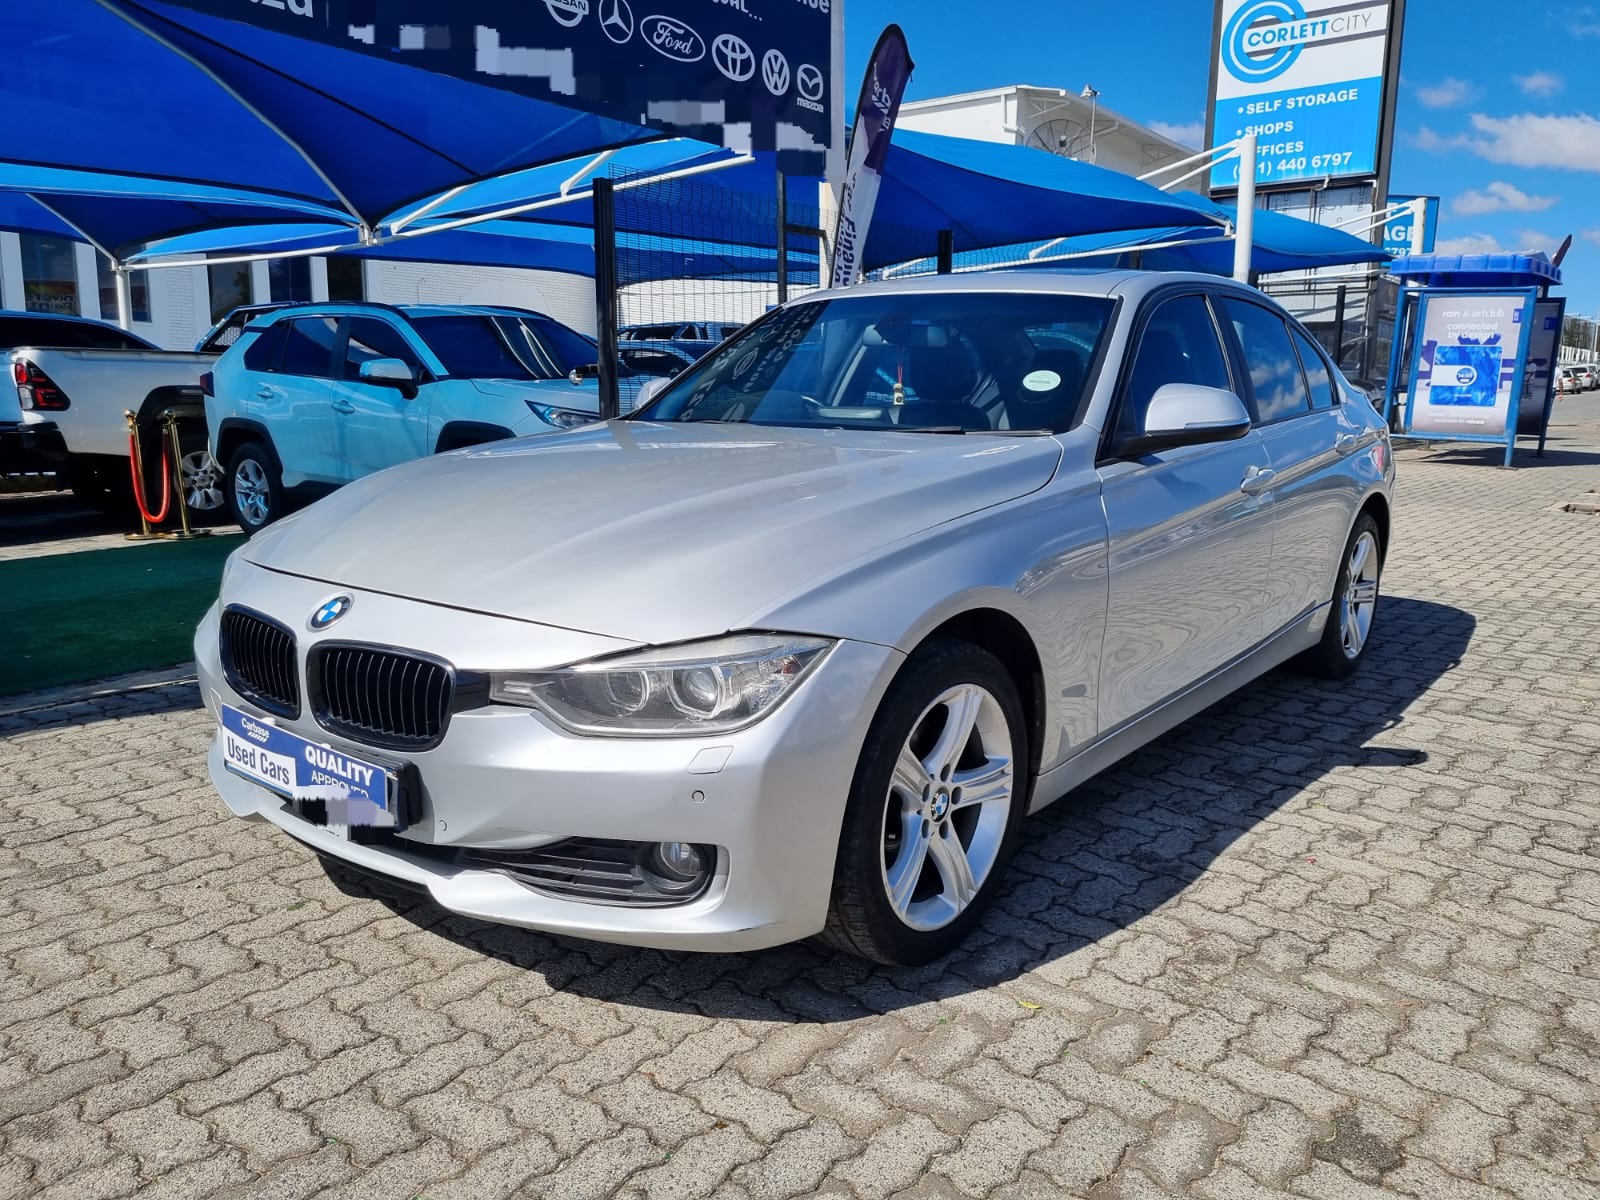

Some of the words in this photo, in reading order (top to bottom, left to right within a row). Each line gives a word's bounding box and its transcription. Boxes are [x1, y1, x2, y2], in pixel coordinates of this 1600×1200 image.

[653, 22, 694, 54] Ford
[797, 97, 824, 113] mazda
[1246, 99, 1282, 115] SELF
[1286, 88, 1358, 109] STORAGE
[1244, 120, 1294, 136] SHOPS
[1256, 141, 1304, 156] FFICES
[1277, 157, 1307, 172] 440
[1311, 151, 1353, 168] 6797
[1446, 322, 1498, 330] connected
[1447, 331, 1460, 340] by
[241, 717, 270, 737] Carbase
[227, 735, 256, 770] Used
[260, 752, 290, 786] Cars
[305, 745, 374, 787] QUALITY
